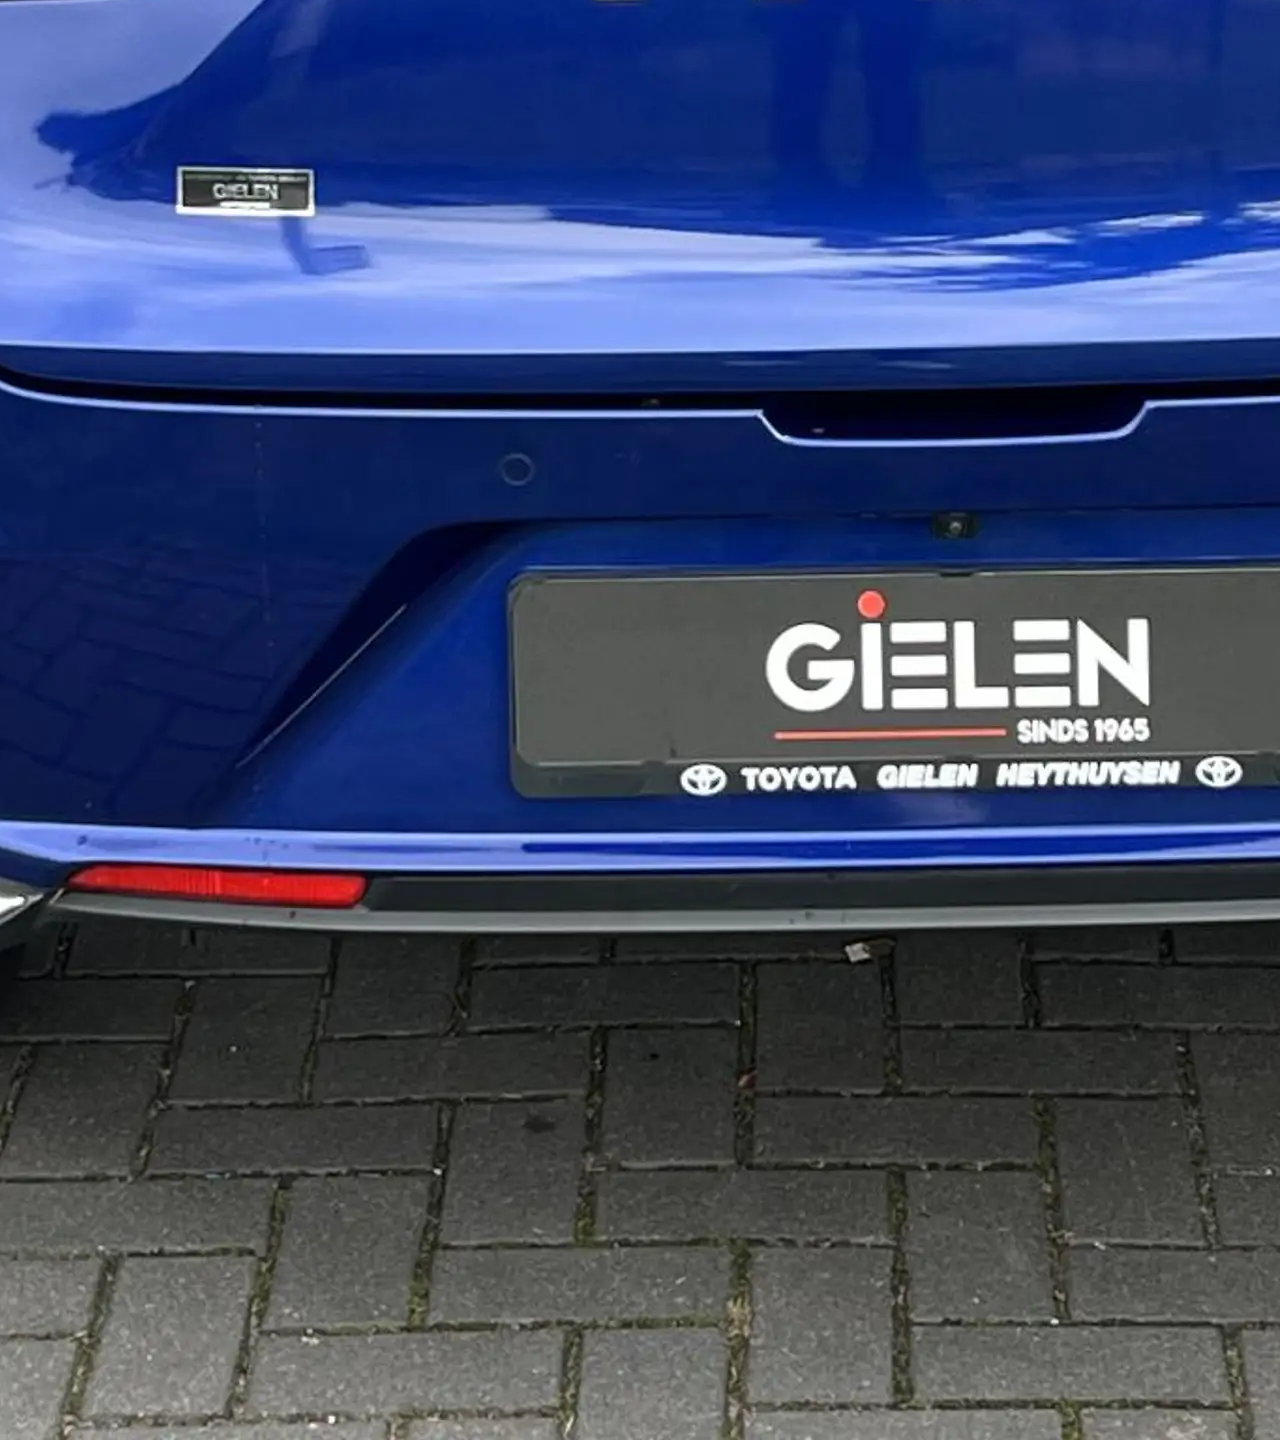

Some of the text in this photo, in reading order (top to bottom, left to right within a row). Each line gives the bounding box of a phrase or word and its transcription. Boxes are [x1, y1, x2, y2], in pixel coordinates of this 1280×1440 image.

[1016, 717, 1151, 744] SINDS 1965
[740, 760, 1181, 791] TOYOTA GIELEN HEYTHUYSEN
